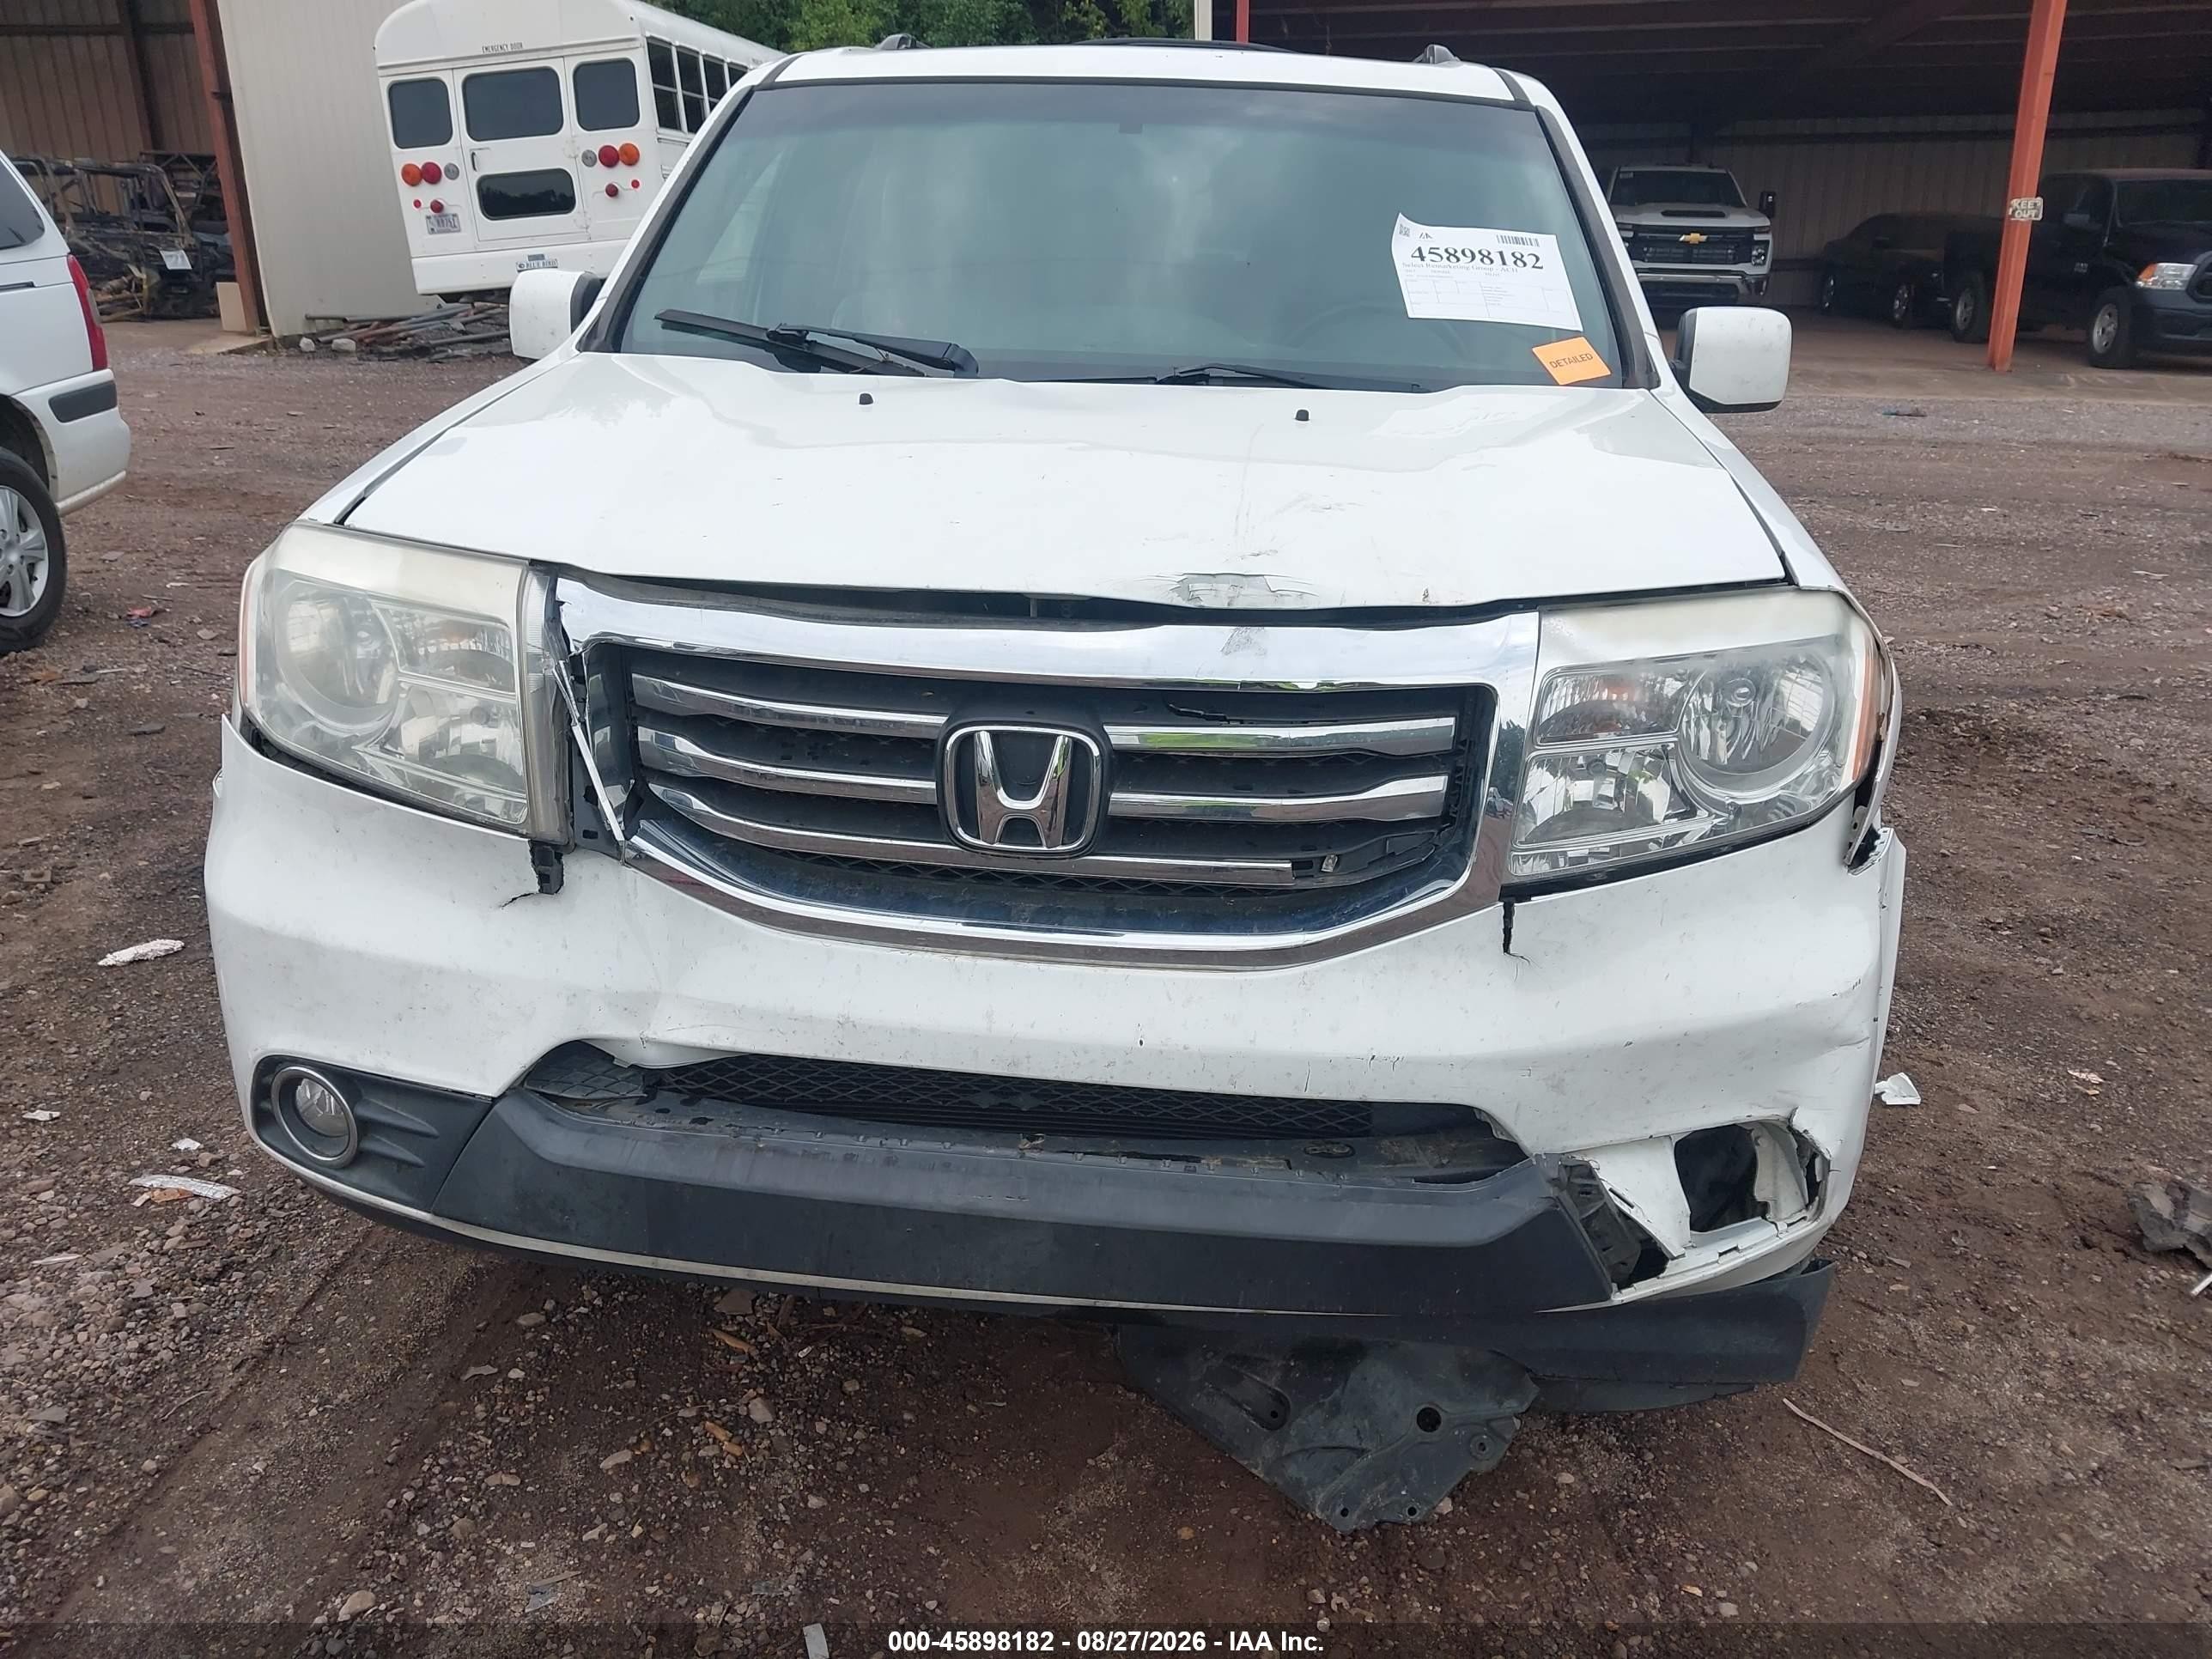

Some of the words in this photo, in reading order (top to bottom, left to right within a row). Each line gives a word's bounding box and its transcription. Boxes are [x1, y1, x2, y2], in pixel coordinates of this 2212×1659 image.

[2011, 198, 2041, 209] KEEP
[2014, 210, 2038, 218] OUT
[1411, 246, 1544, 270] 45898182
[1549, 353, 1593, 368] DETAILED
